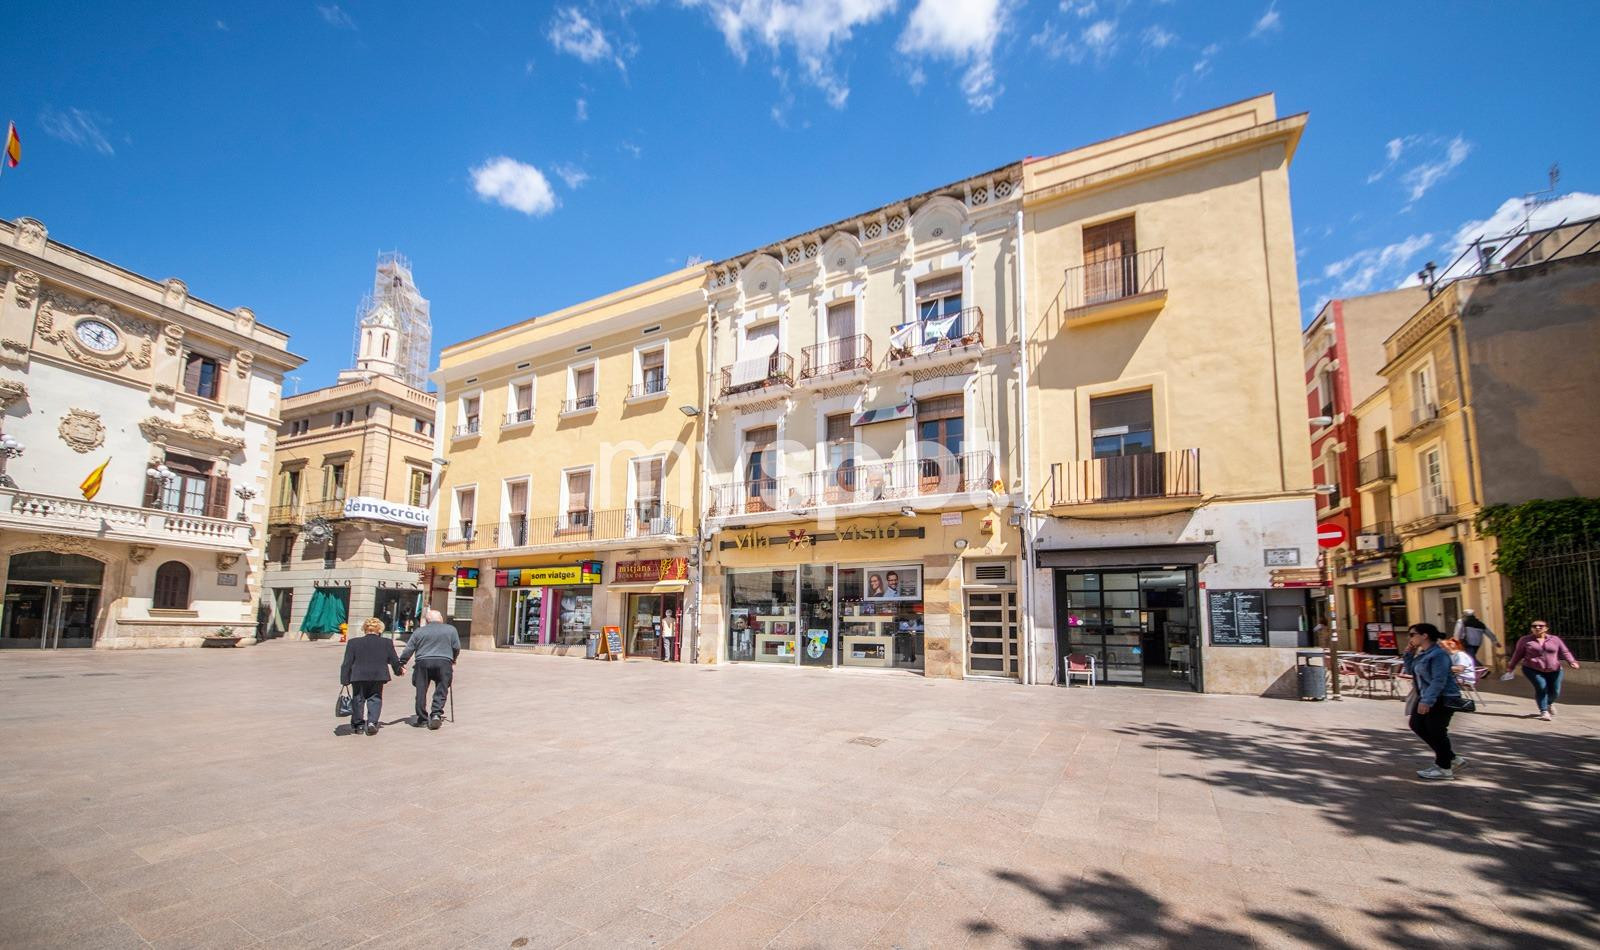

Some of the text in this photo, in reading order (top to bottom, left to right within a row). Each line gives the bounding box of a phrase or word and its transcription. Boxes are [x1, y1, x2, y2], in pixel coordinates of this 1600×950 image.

[619, 564, 651, 574] mitjans
[547, 571, 576, 580] viatges
[313, 579, 352, 588] RENO
